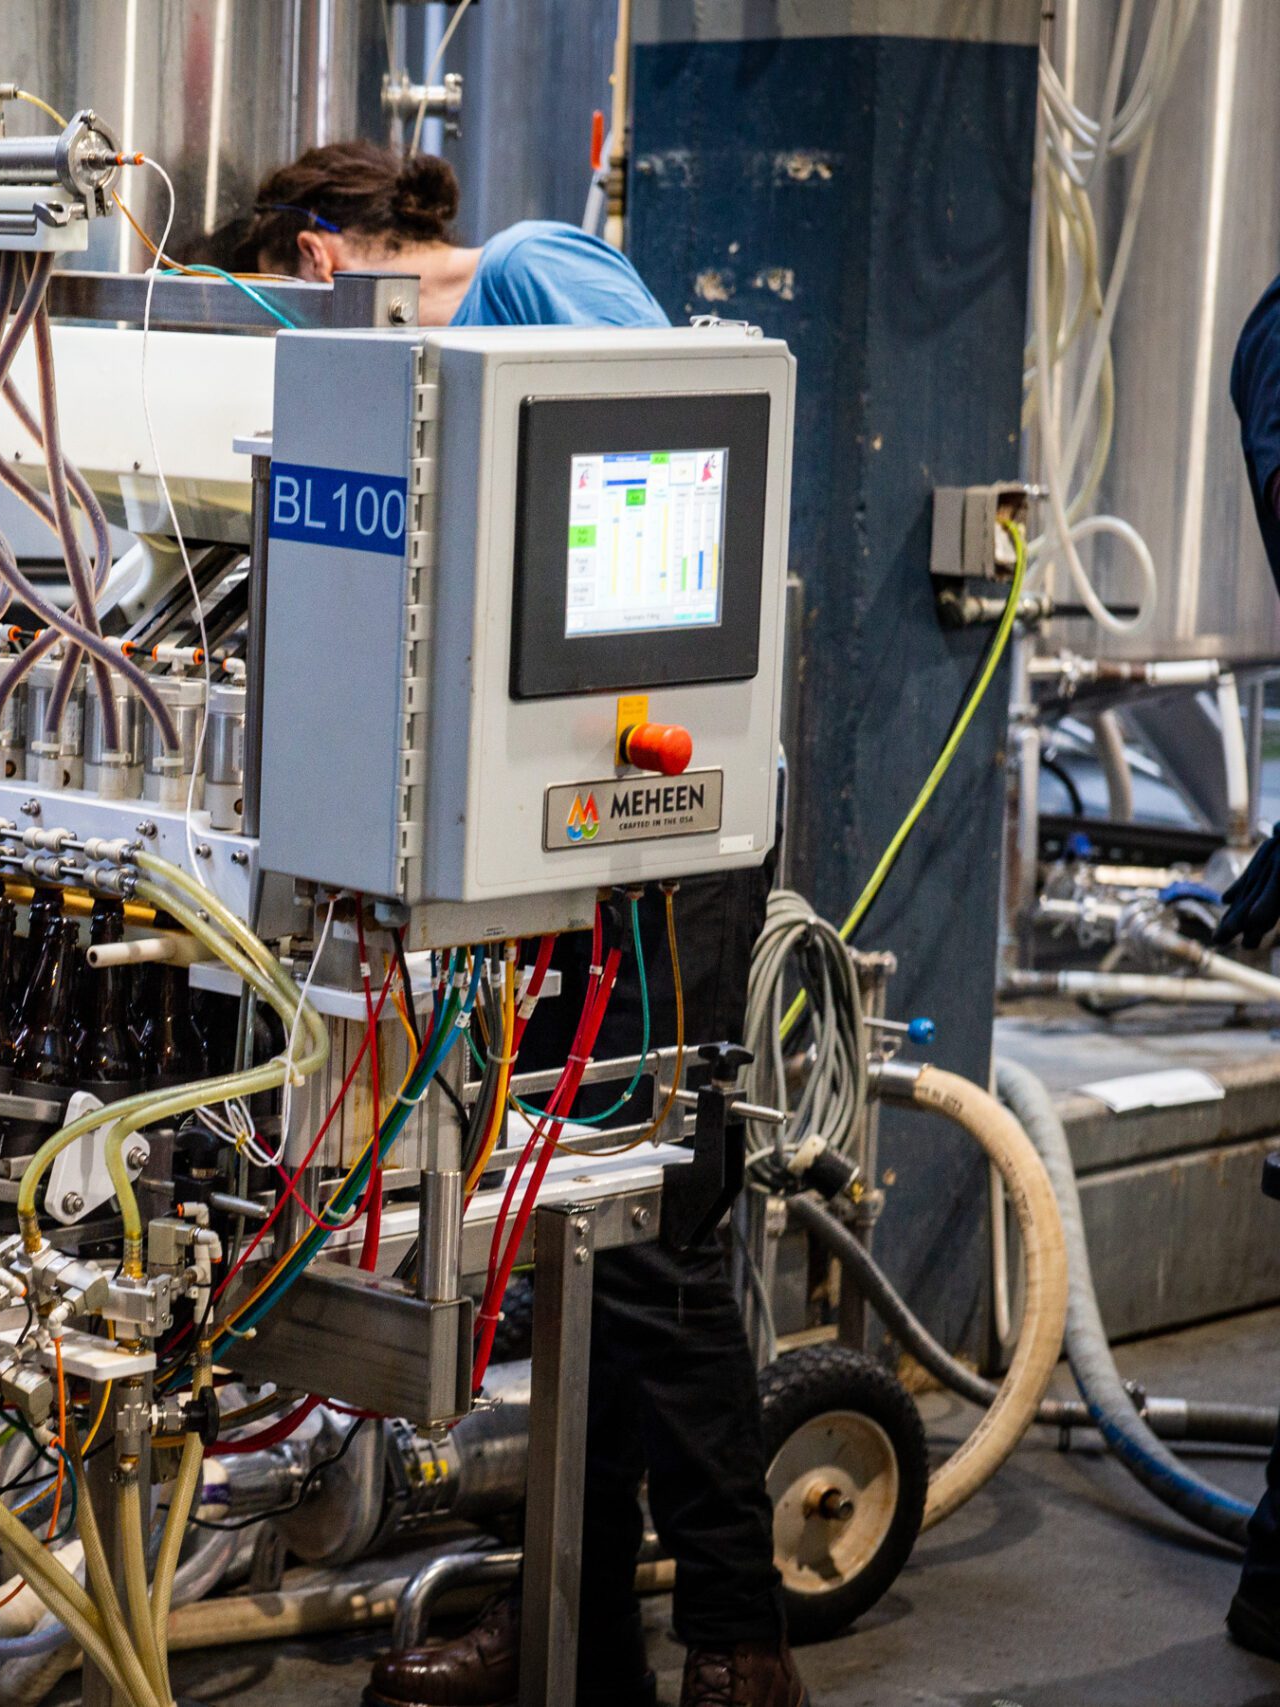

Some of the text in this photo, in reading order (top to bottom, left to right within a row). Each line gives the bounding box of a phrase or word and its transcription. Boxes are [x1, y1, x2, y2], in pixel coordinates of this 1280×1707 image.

[273, 475, 406, 540] BL100
[610, 783, 705, 819] MEHEEN
[618, 815, 694, 831] CRAFTED IN THE USA
